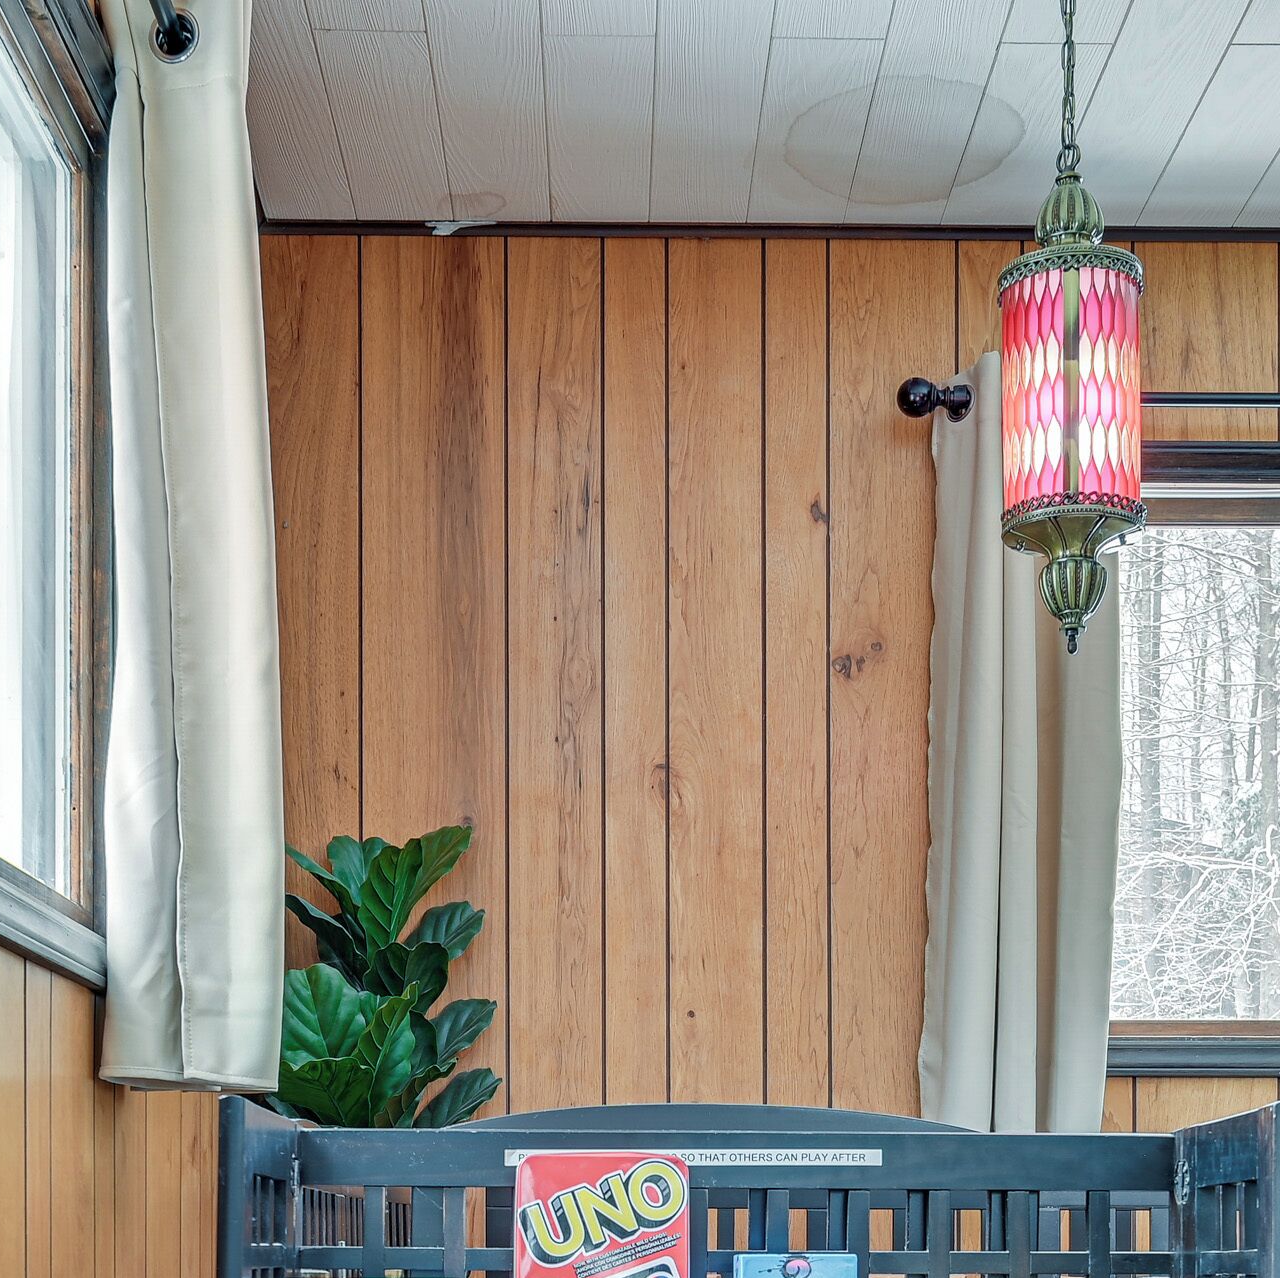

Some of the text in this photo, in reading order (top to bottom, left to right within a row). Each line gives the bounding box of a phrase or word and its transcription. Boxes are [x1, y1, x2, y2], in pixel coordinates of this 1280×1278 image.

[681, 1153, 866, 1162] SO THAT OTHERS CAN PLAY AFTER
[520, 1158, 687, 1266] UNO
